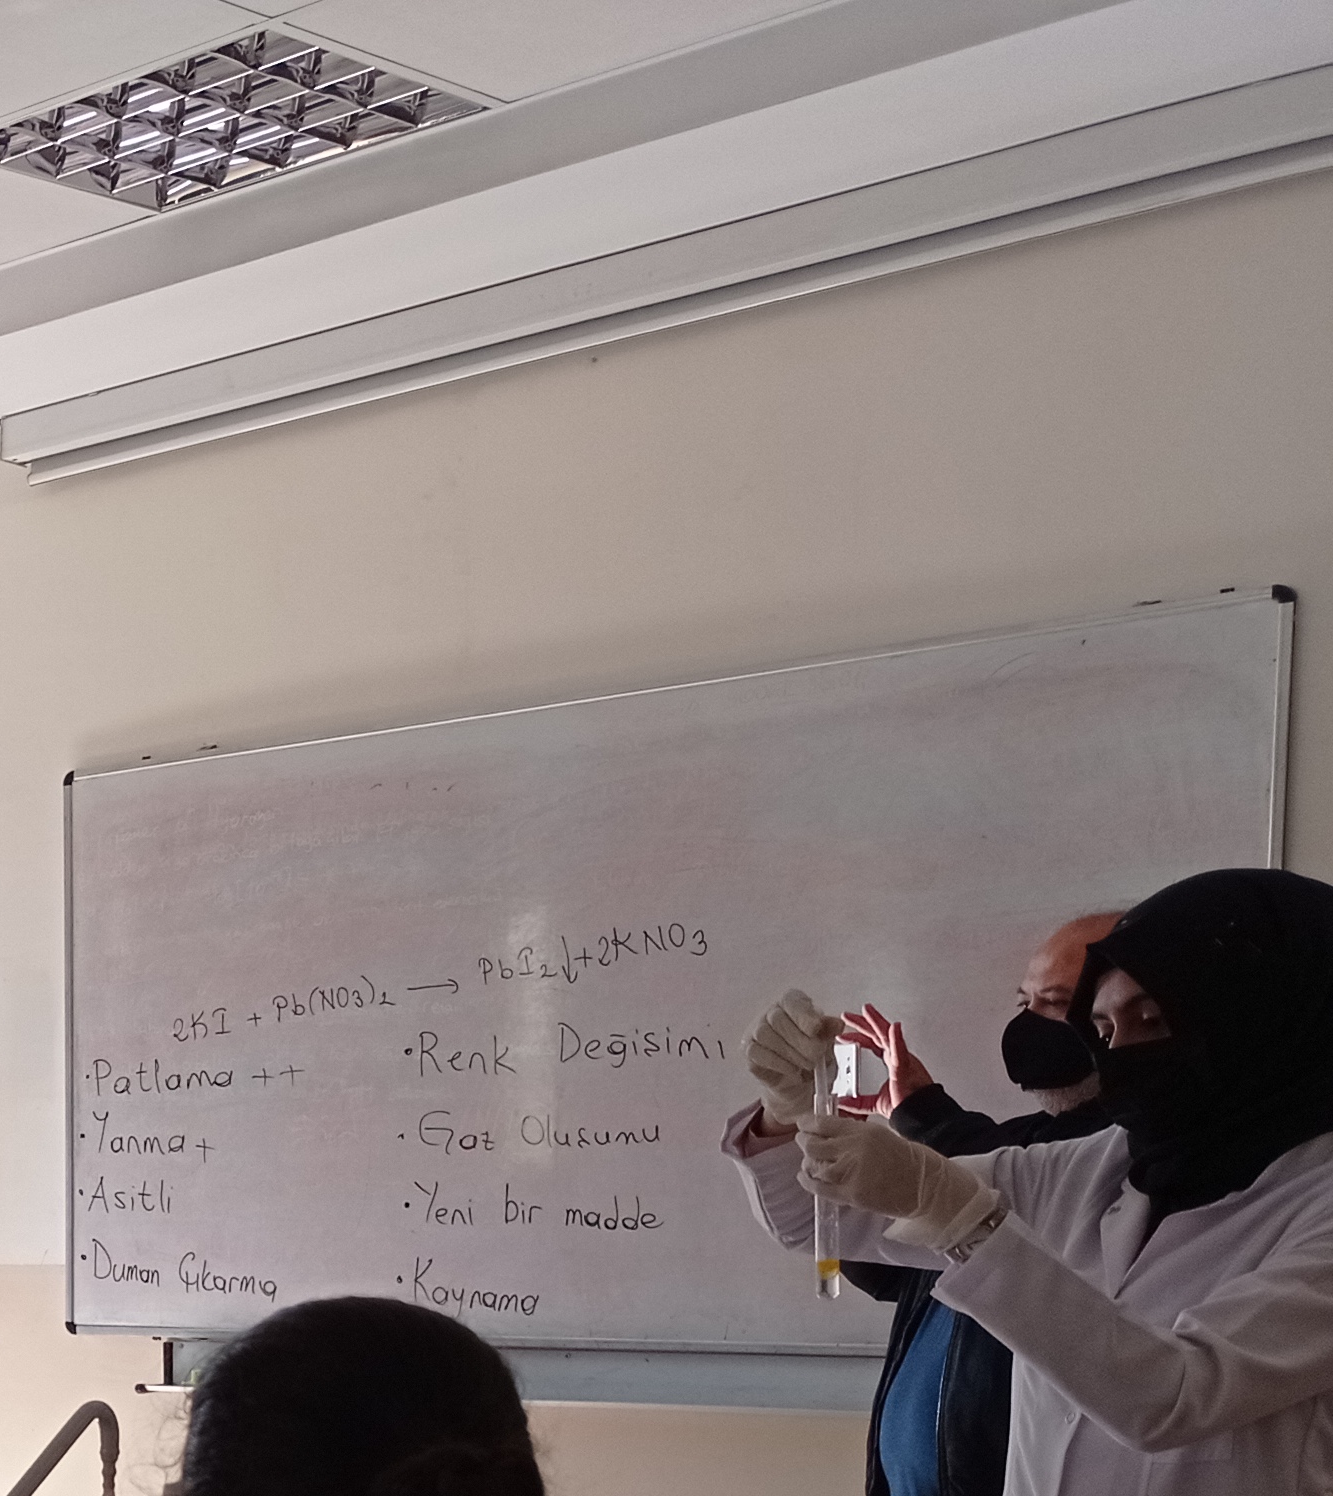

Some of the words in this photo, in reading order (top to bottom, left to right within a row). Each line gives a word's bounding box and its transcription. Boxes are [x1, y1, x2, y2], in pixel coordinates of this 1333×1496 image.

[419, 1031, 516, 1077] Renk
[93, 1059, 233, 1096] Patlama
[92, 1111, 185, 1154] Yanma
[419, 1111, 495, 1155] Gaz
[88, 1176, 173, 1213] Asitli
[414, 1181, 473, 1226] Yeni
[505, 1183, 542, 1224] bir
[565, 1195, 664, 1230] madde
[92, 1238, 160, 1287] Duman
[414, 1256, 539, 1319] Kaynama
